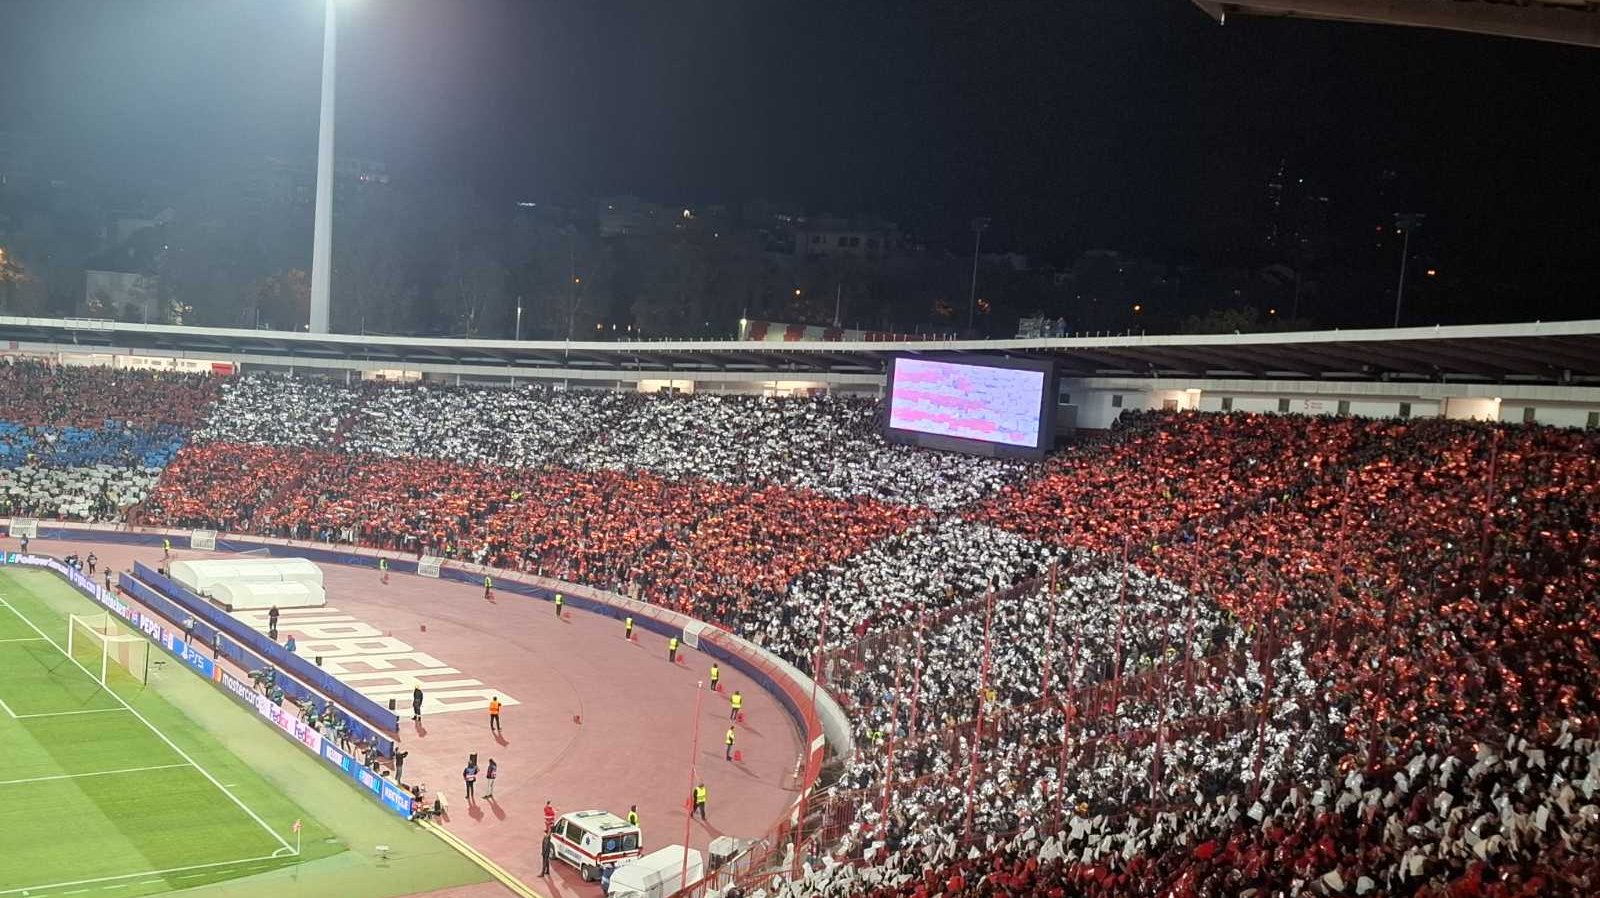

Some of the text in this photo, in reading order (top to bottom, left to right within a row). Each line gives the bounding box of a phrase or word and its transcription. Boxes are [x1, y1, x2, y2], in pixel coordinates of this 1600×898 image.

[139, 612, 161, 640] PEPSI
[188, 651, 204, 669] PS5
[269, 703, 288, 729] FedEx
[294, 719, 315, 748] FedEx
[384, 786, 409, 810] RECYCLE
